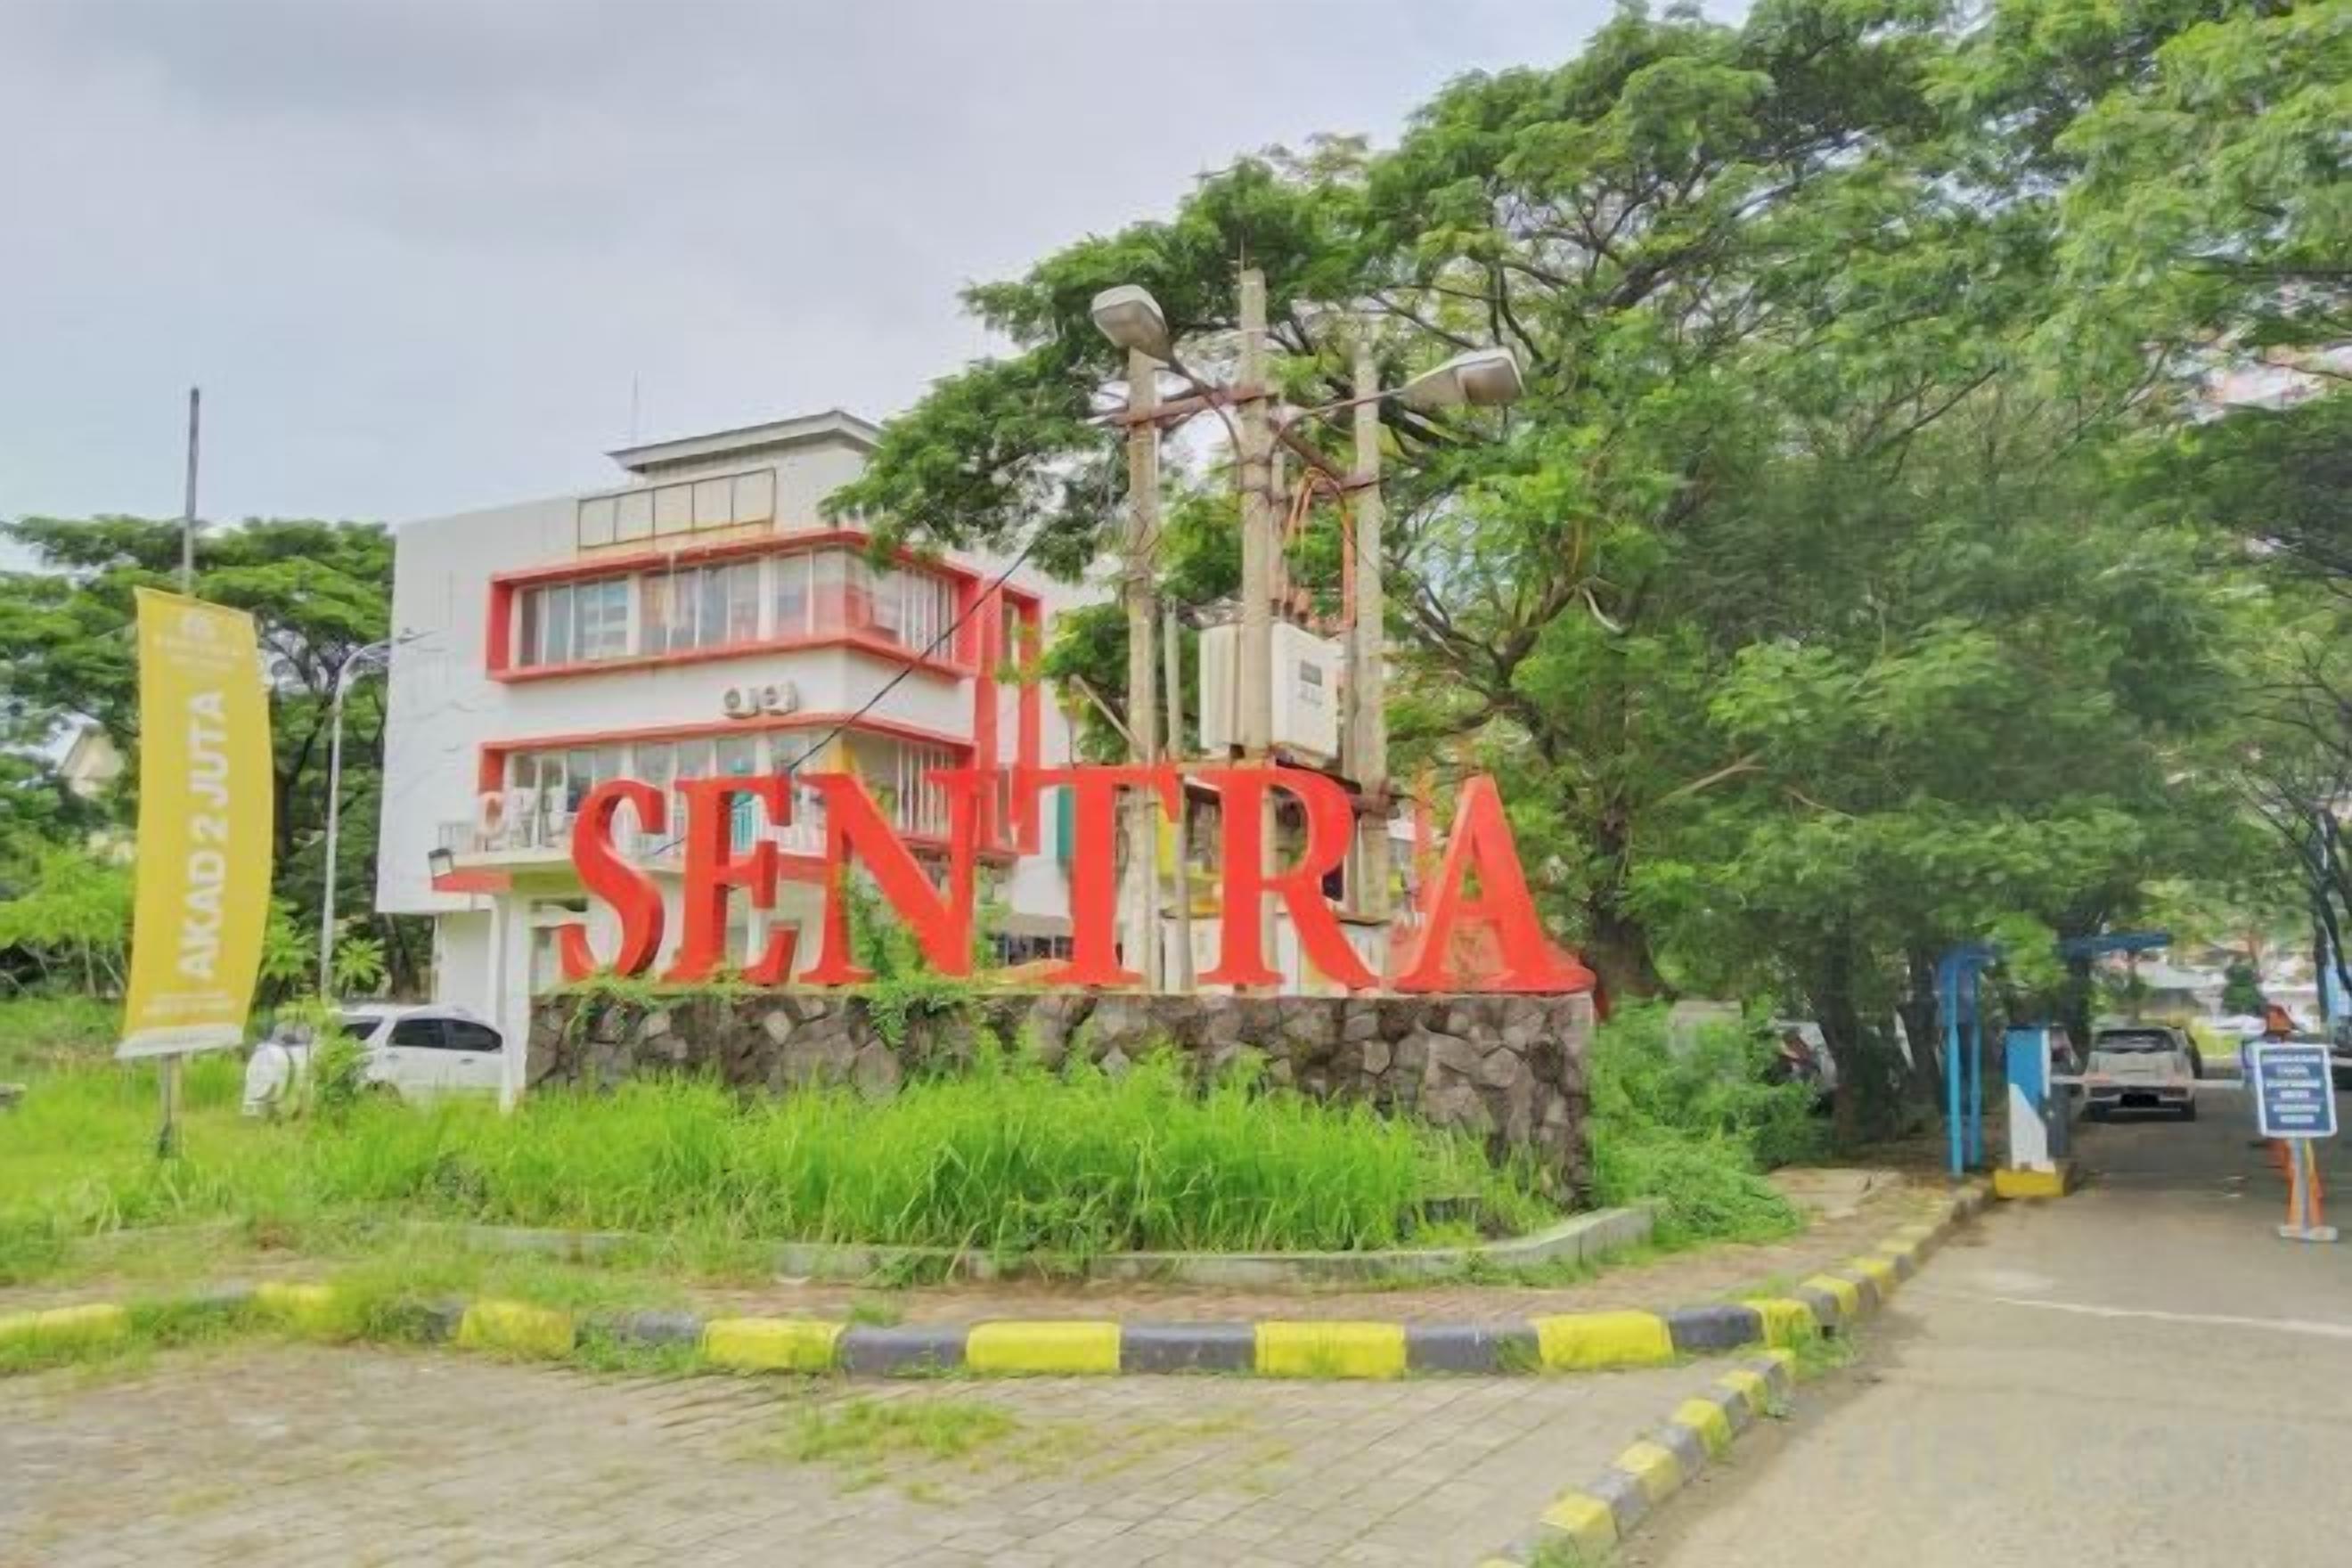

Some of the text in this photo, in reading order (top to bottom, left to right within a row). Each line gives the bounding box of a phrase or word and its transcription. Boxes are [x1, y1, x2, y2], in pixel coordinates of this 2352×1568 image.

[185, 690, 229, 807] JUTA
[188, 813, 229, 842] 2
[559, 764, 1593, 992] SENTRA
[178, 851, 225, 979] AKAD
